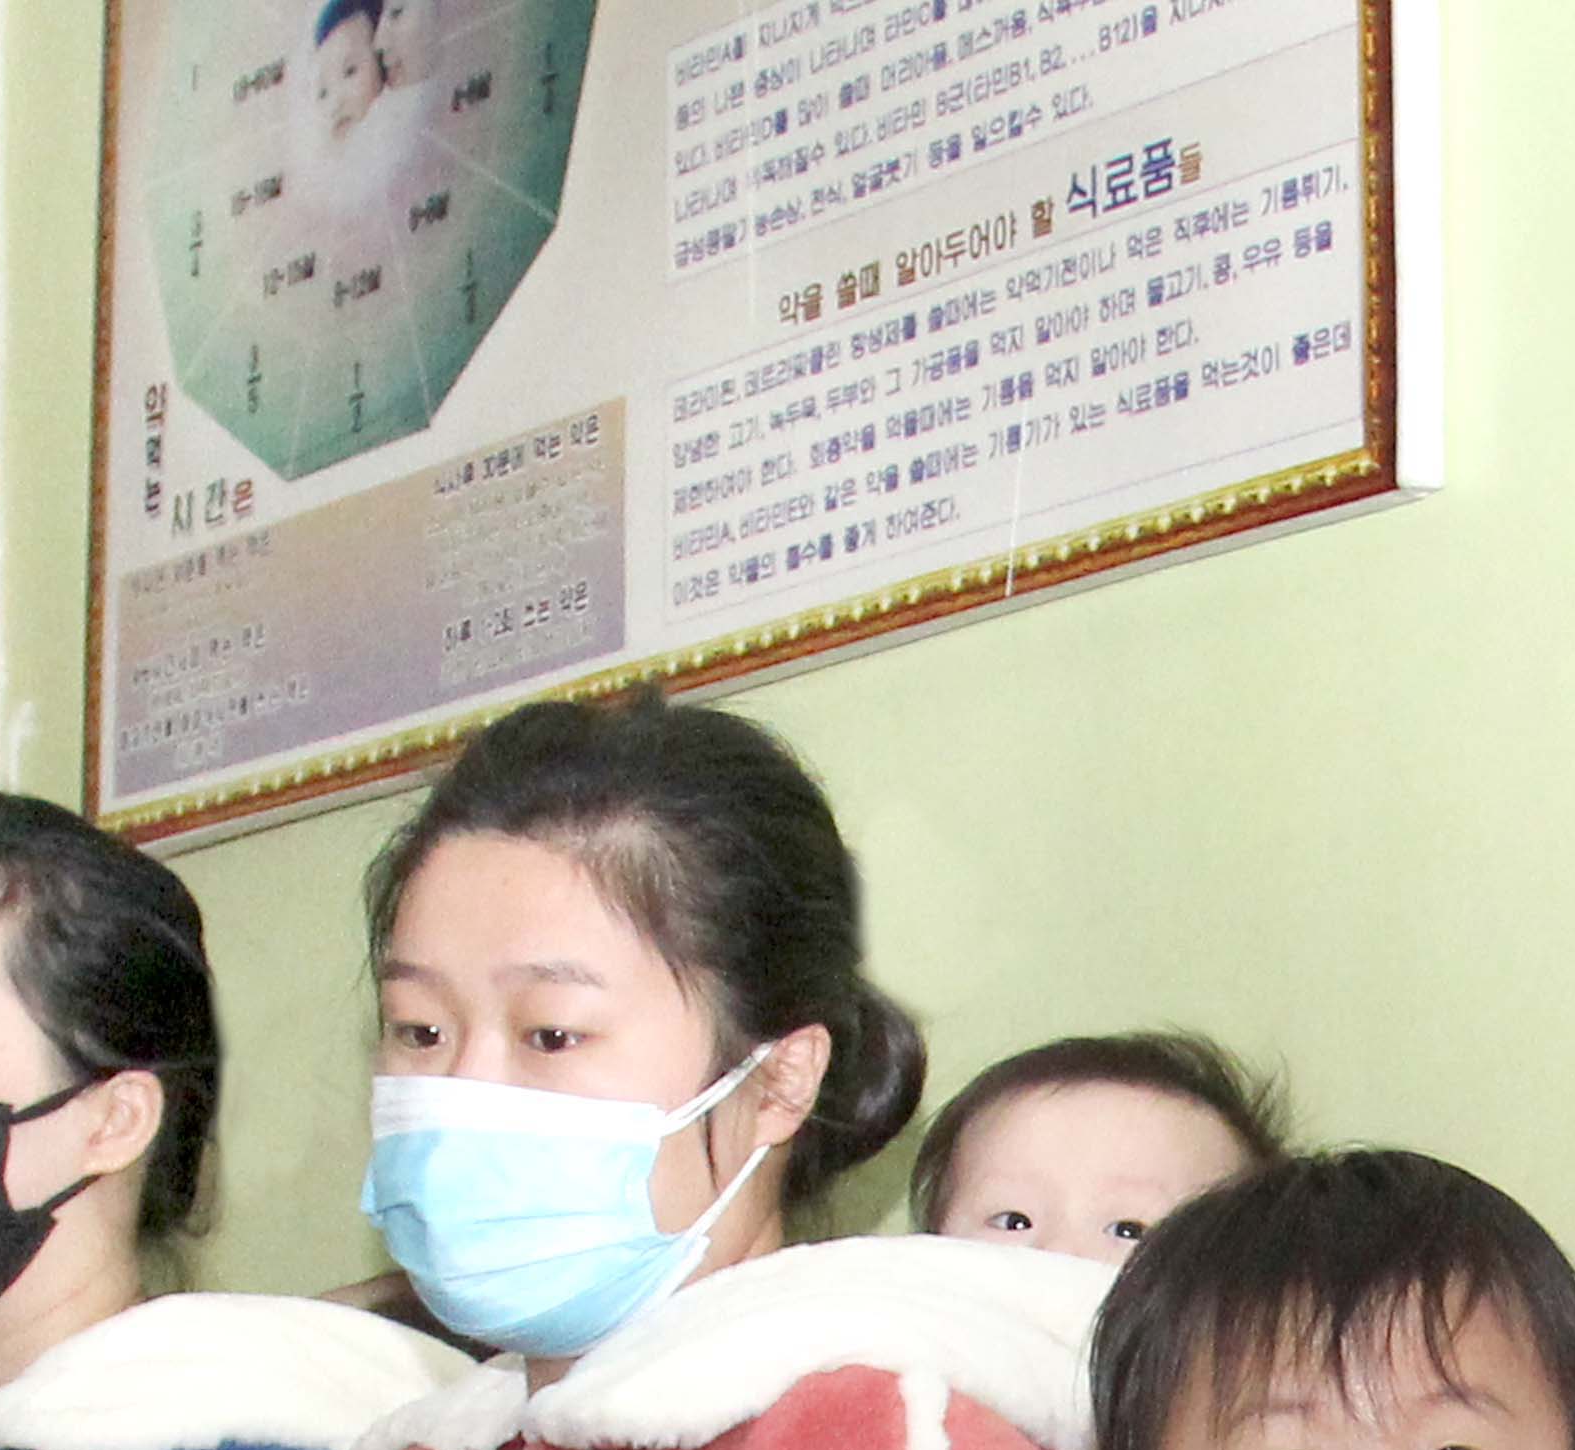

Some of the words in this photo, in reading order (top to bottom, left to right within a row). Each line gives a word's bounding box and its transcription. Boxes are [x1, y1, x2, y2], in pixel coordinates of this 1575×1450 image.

[779, 283, 824, 325] 약을
[836, 261, 881, 309] 쓸때
[895, 211, 1018, 287] 알아두어야
[1031, 196, 1055, 239] 할
[1066, 137, 1202, 219] 식료품들
[1241, 237, 1283, 273] 우유
[1069, 403, 1107, 435] 있는
